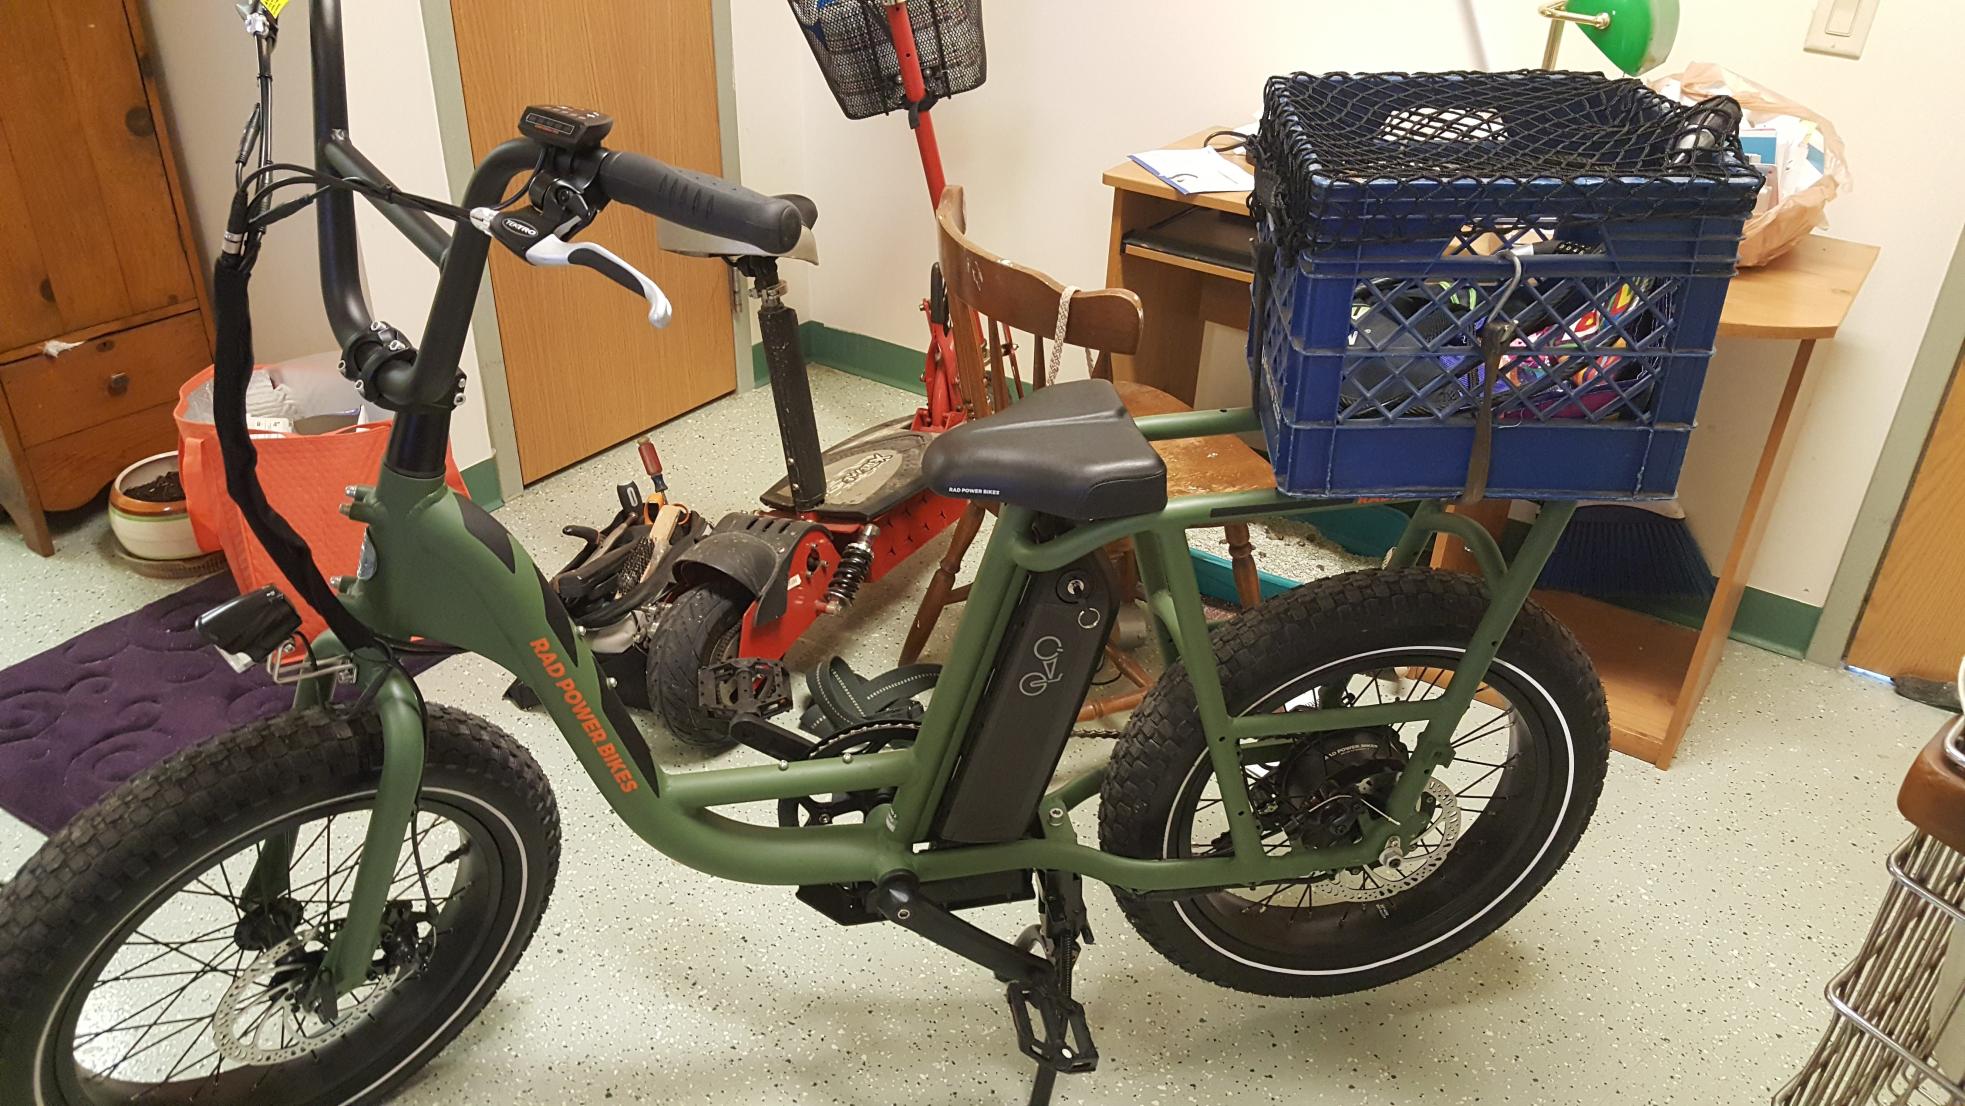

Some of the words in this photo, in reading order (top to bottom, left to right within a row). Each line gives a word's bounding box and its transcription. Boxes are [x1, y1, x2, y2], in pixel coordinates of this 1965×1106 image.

[505, 219, 536, 235] TEKTRO
[529, 637, 567, 679] RAD
[555, 678, 608, 745] POWER
[597, 742, 639, 794] BIKES
